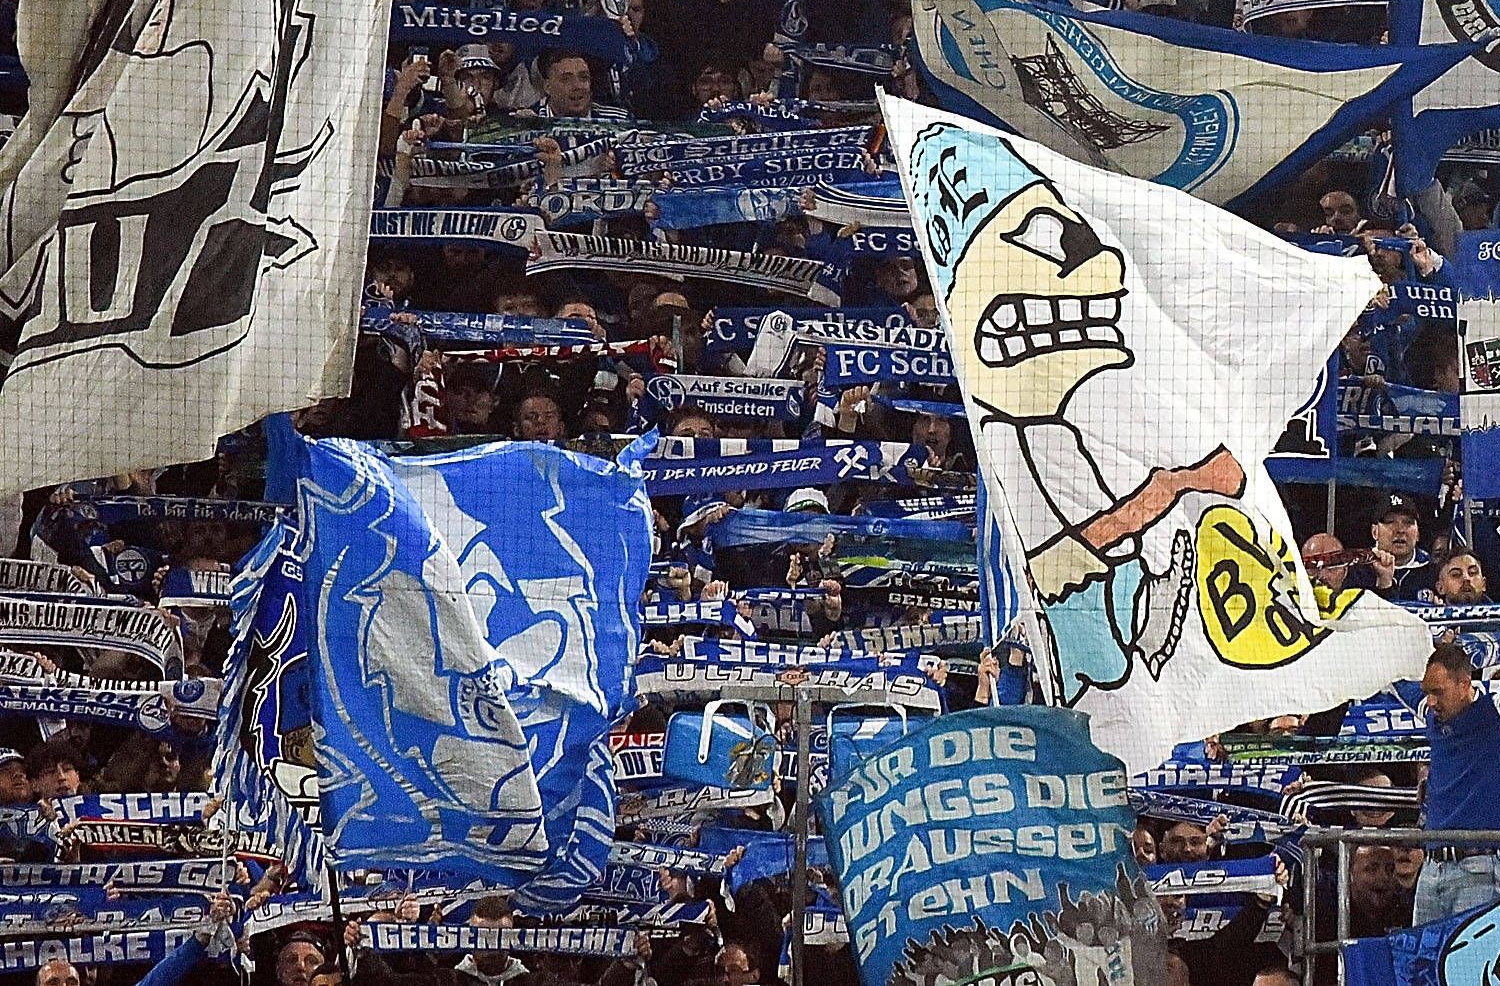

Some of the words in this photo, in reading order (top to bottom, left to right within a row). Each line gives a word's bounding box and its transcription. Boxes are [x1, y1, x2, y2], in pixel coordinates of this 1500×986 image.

[400, 5, 563, 35] Mitglied
[411, 213, 437, 234] NIE
[441, 213, 498, 236] ALLEIN!
[1407, 286, 1451, 302] und
[1416, 303, 1454, 318] ein
[839, 350, 880, 376] FC
[691, 381, 720, 396] Auf
[725, 382, 785, 397] Schalke
[697, 401, 775, 416] Emsdetten
[663, 467, 697, 481] DER
[701, 462, 768, 480] TAUSEND
[771, 456, 821, 474] FEUER
[192, 570, 230, 591] WIR
[35, 604, 70, 626] FÜR
[75, 609, 101, 629] DIE
[1326, 751, 1372, 764] LEIDEN
[1376, 751, 1391, 763] IM
[834, 747, 914, 820] FÜR
[930, 725, 1035, 764] DIE
[1027, 773, 1125, 809] DIE
